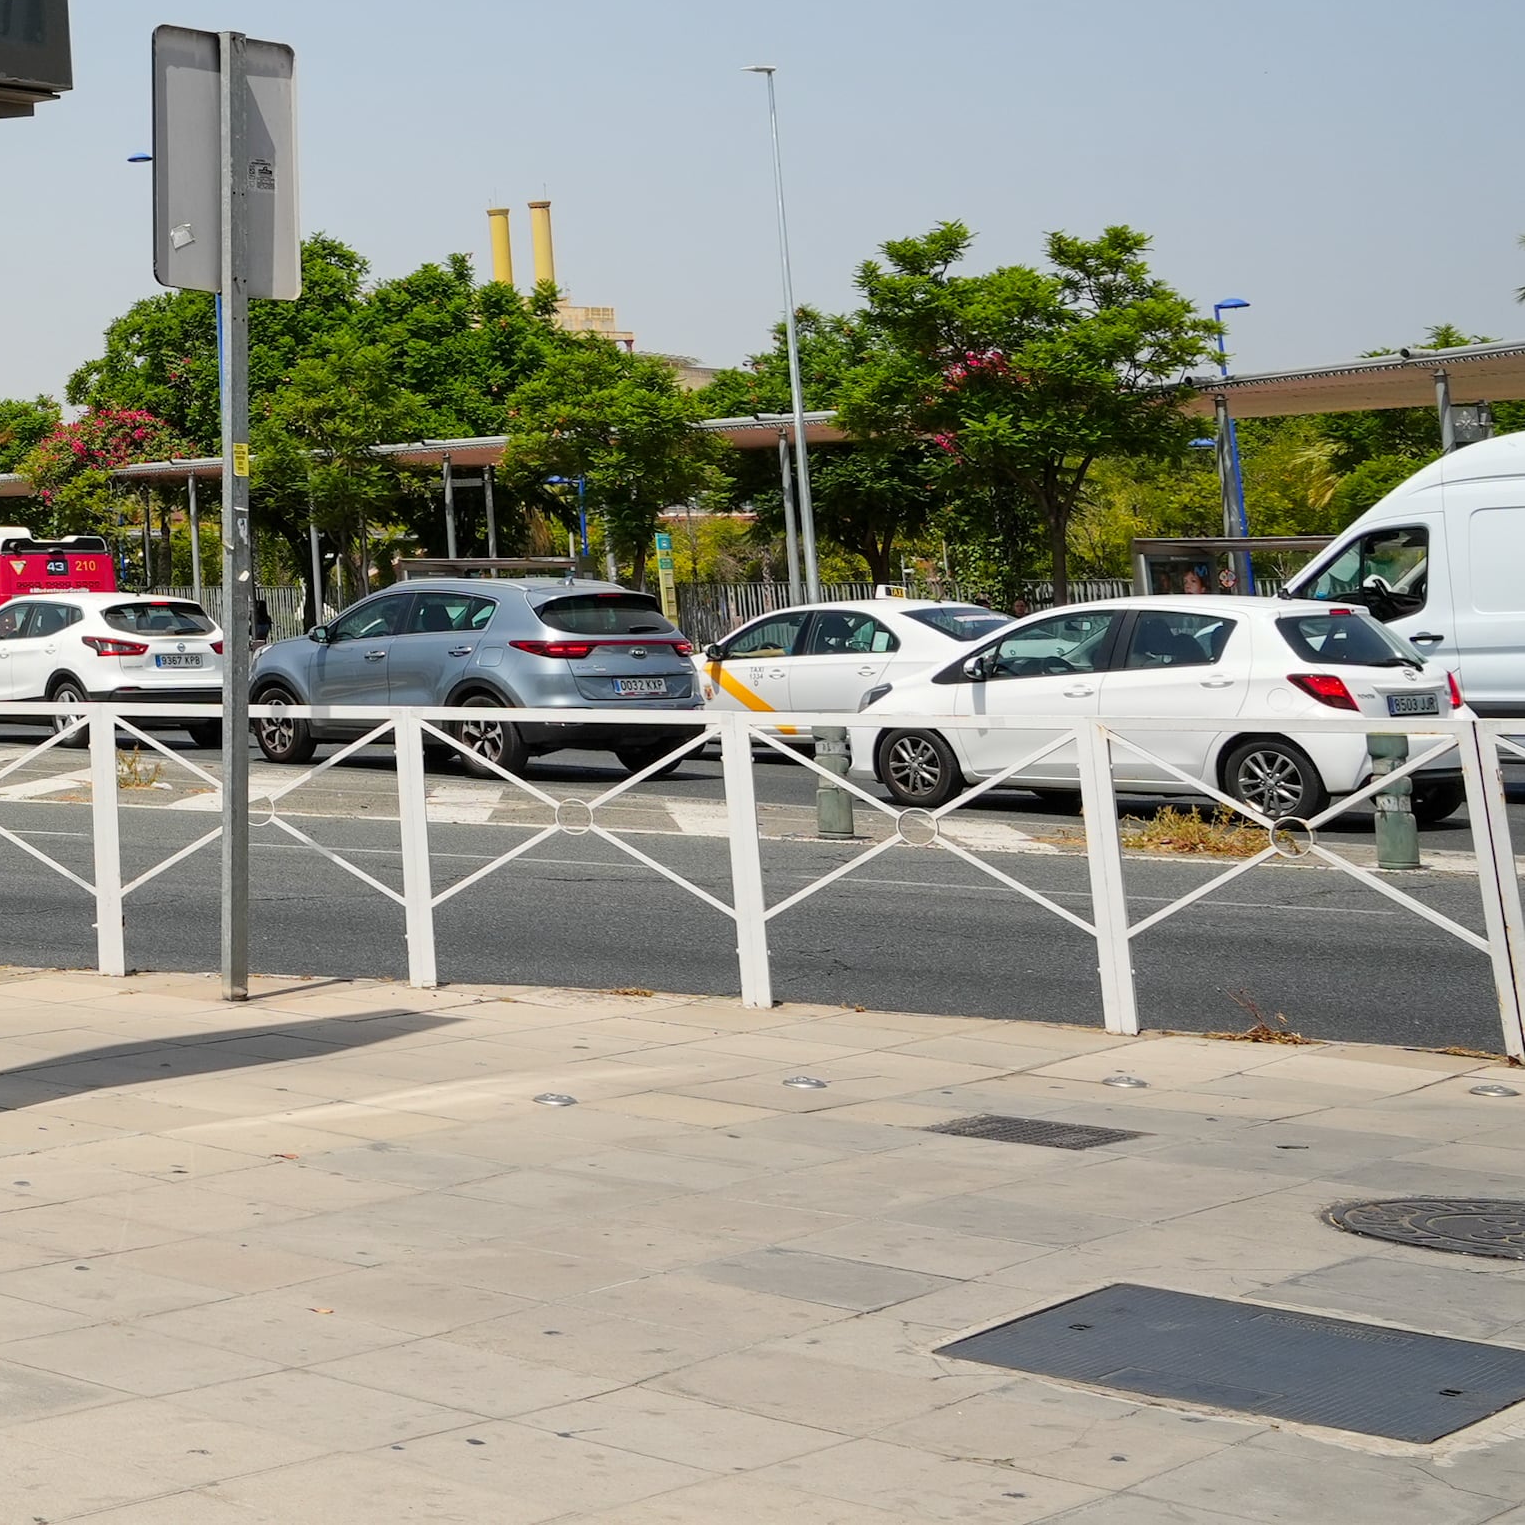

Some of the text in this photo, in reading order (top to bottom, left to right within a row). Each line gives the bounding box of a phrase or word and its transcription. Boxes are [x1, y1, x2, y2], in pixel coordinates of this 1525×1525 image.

[46, 561, 65, 572] 43
[75, 560, 97, 572] 210
[161, 656, 201, 666] 9367 KPB
[620, 679, 664, 691] 0032 KXP
[1394, 698, 1418, 712] 8503
